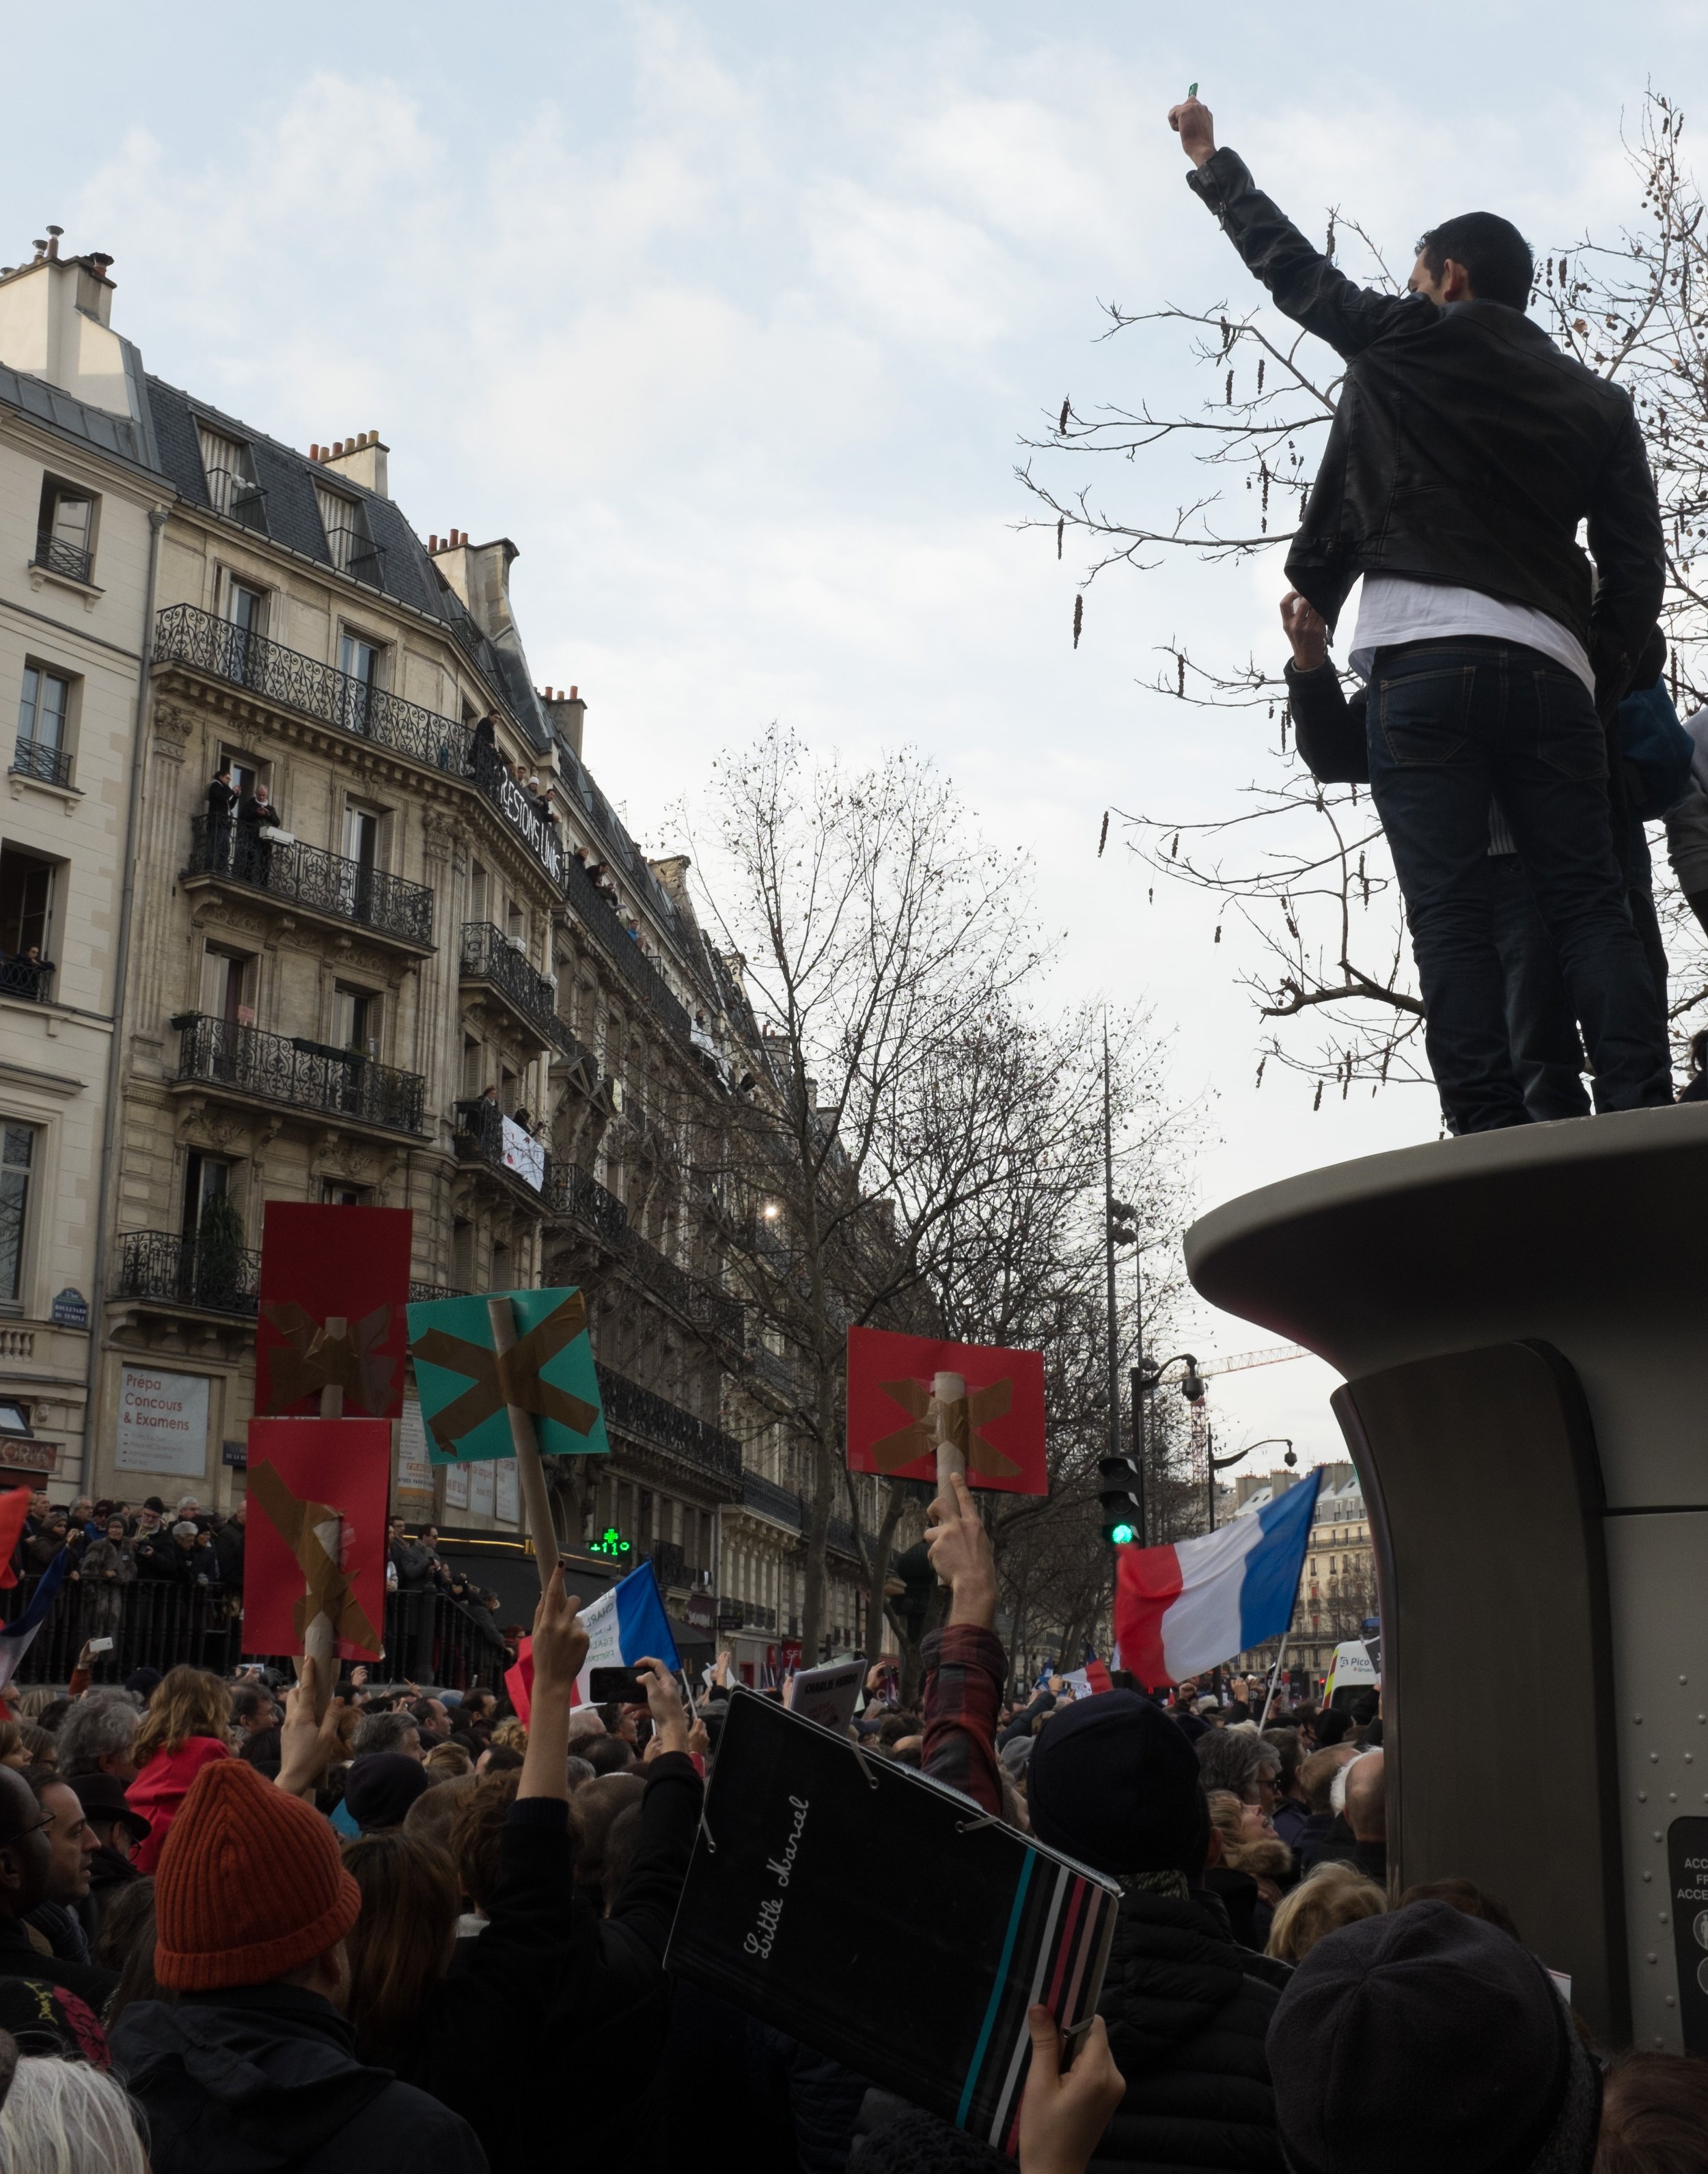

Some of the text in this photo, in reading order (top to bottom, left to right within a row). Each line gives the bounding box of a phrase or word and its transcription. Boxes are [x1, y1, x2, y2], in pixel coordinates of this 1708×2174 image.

[500, 765, 561, 883] RESTONS UNIS
[55, 1304, 87, 1315] BOULEVARD
[64, 1313, 85, 1321] TEMPLE
[126, 1373, 161, 1392] Prépa
[125, 1392, 182, 1412] Concours
[124, 1411, 189, 1431] & Examens
[786, 1650, 801, 1660] SF
[1351, 1657, 1369, 1666] Pico
[805, 1673, 858, 1694] CHARLIE HEBDO
[743, 1795, 809, 1959] Little Marcel
